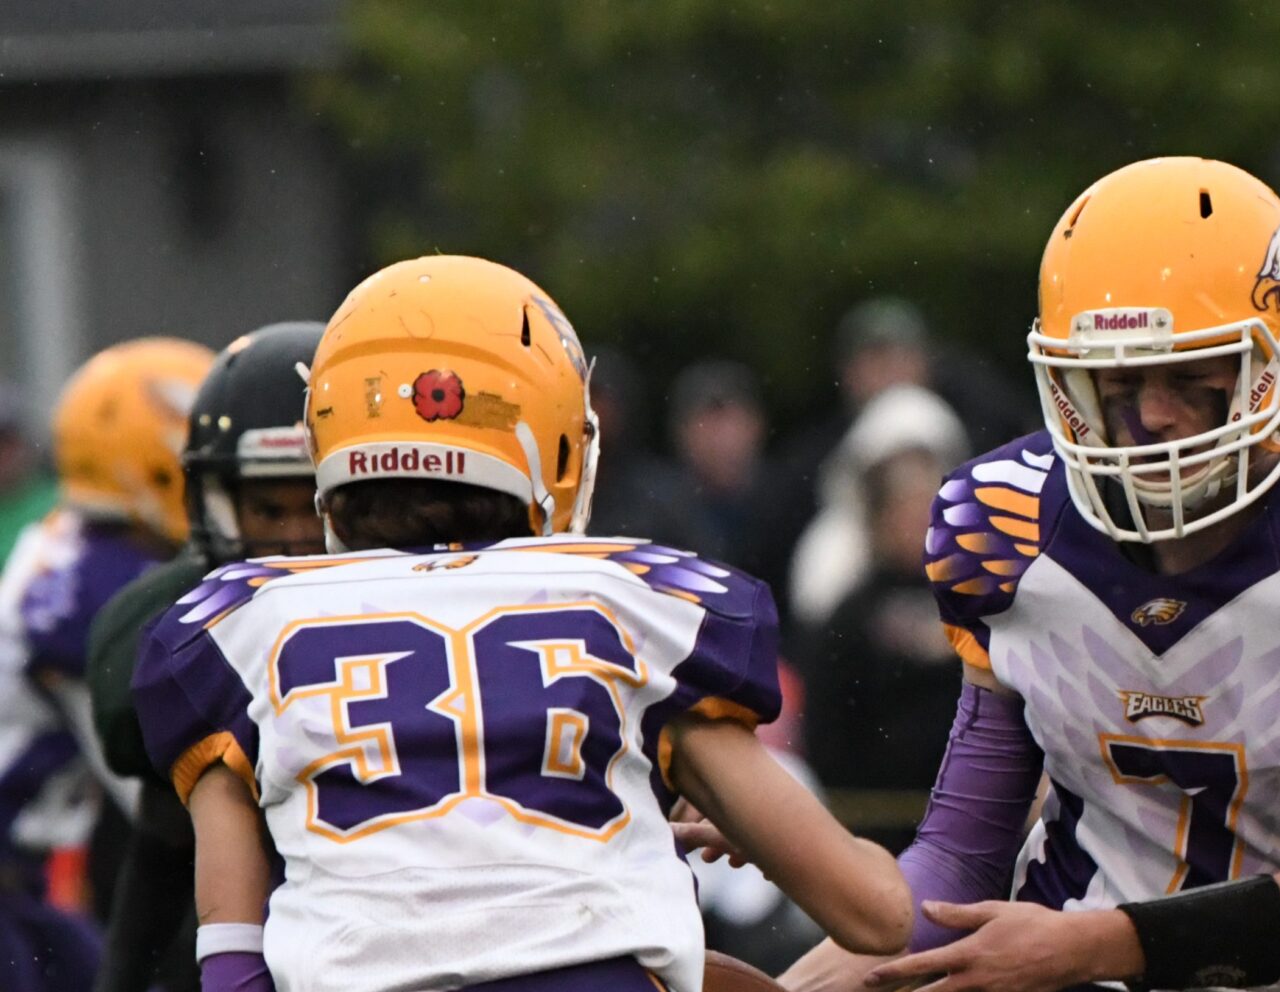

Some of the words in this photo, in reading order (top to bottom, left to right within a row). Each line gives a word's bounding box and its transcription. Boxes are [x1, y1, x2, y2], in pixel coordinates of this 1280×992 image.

[1093, 312, 1148, 331] Riddell
[349, 447, 466, 476] Riddell
[266, 602, 648, 843] 36
[1124, 692, 1203, 723] EAGLES
[1098, 733, 1249, 895] 7
